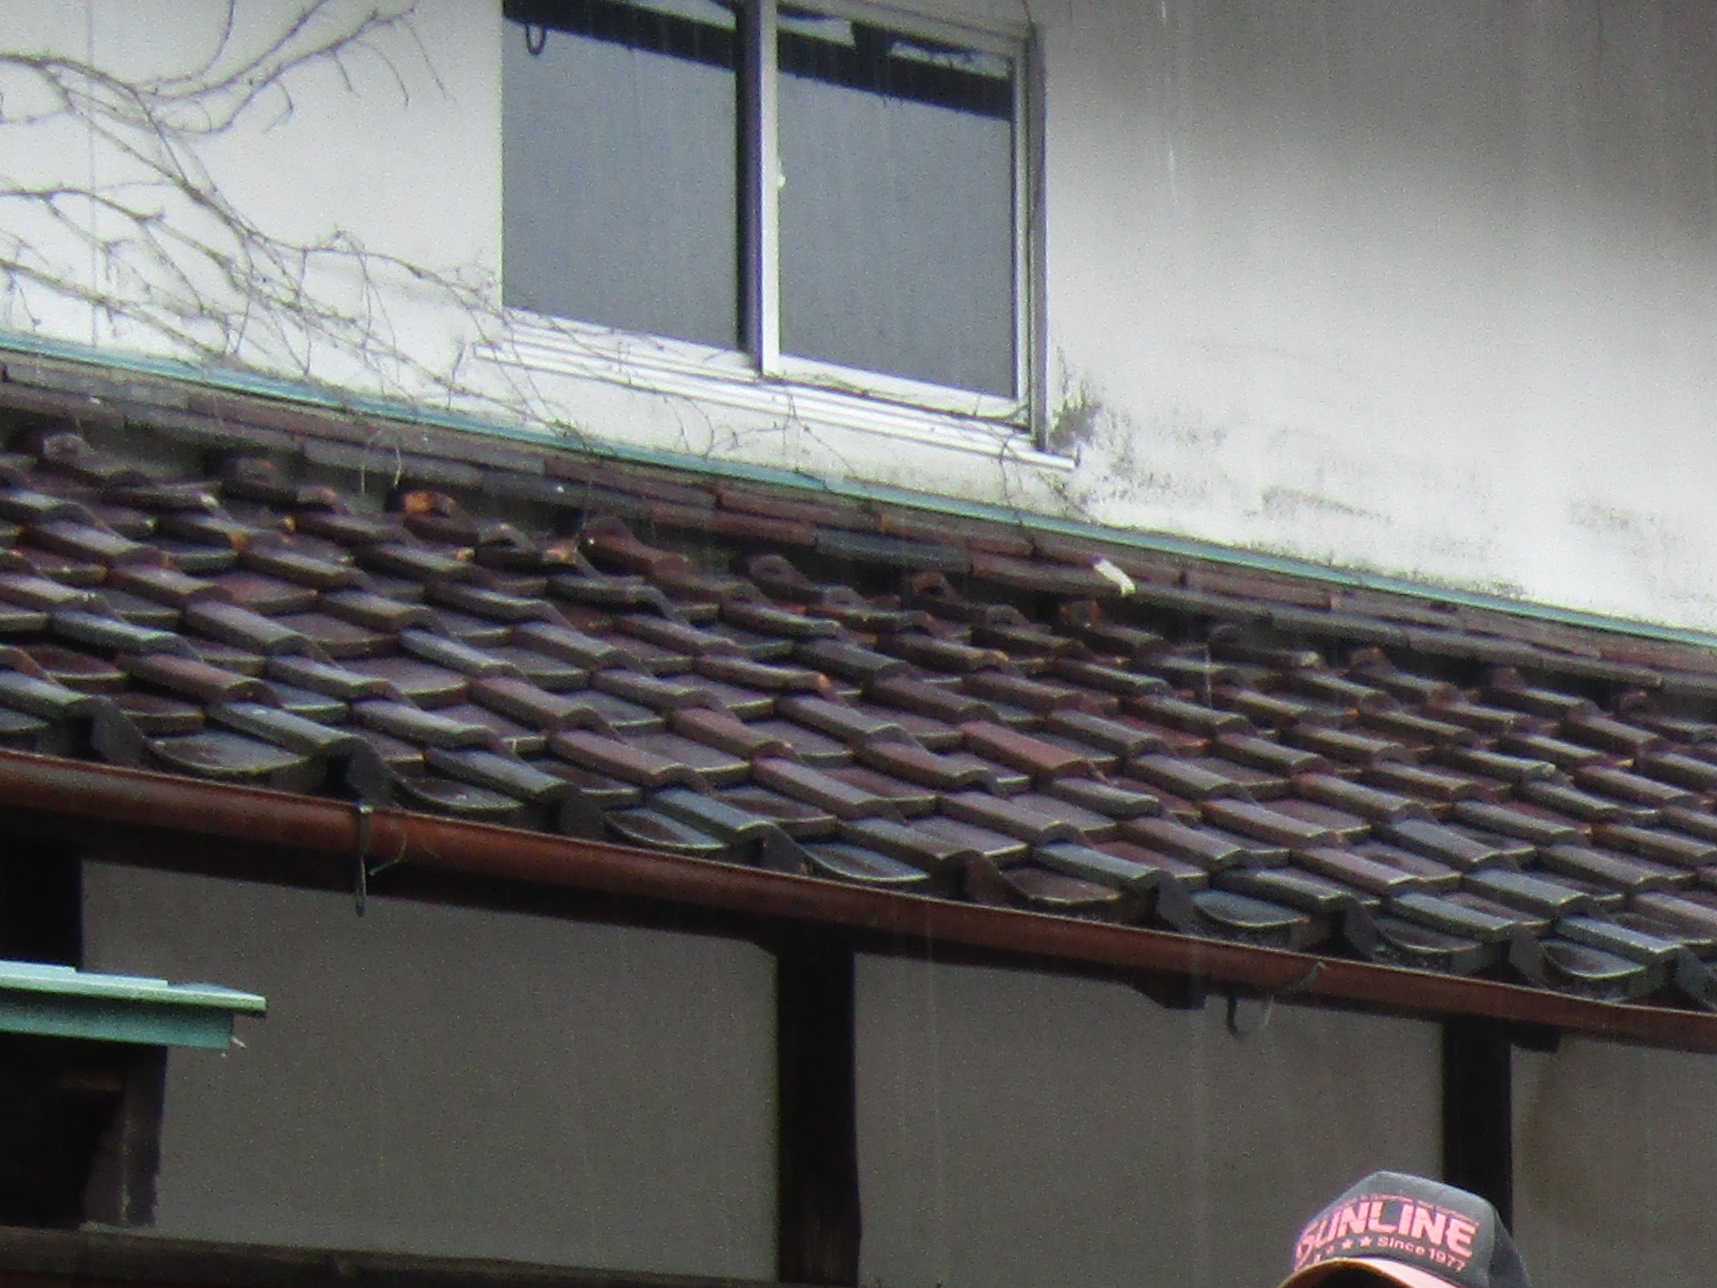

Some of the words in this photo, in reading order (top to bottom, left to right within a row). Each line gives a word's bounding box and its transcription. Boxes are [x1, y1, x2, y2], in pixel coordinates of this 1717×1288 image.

[1295, 1200, 1479, 1265] SUNLINE
[1377, 1236, 1425, 1256] Since
[1429, 1247, 1467, 1272] 1977
